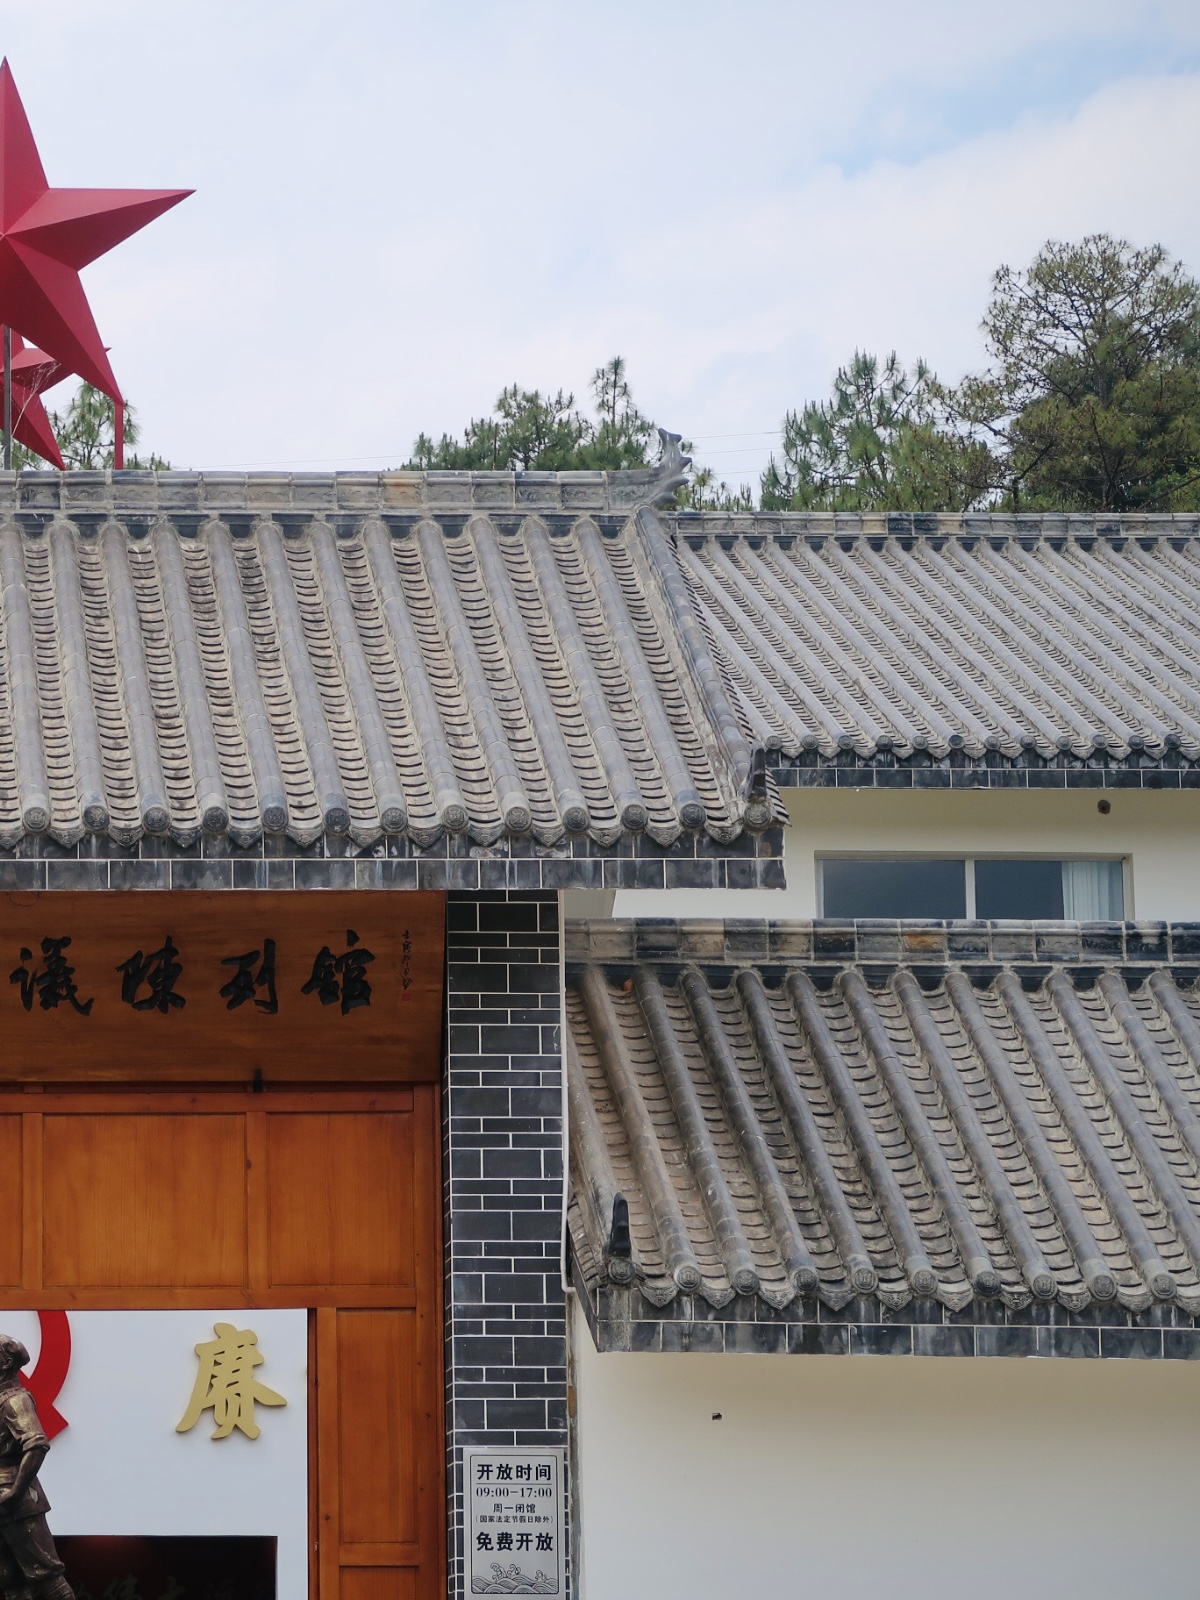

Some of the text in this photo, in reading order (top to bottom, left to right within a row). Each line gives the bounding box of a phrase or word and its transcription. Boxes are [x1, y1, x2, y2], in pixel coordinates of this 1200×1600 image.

[476, 1463, 552, 1481] 开放时间
[492, 1503, 536, 1514] 周一闭馆
[475, 1531, 554, 1552] 免费开放
